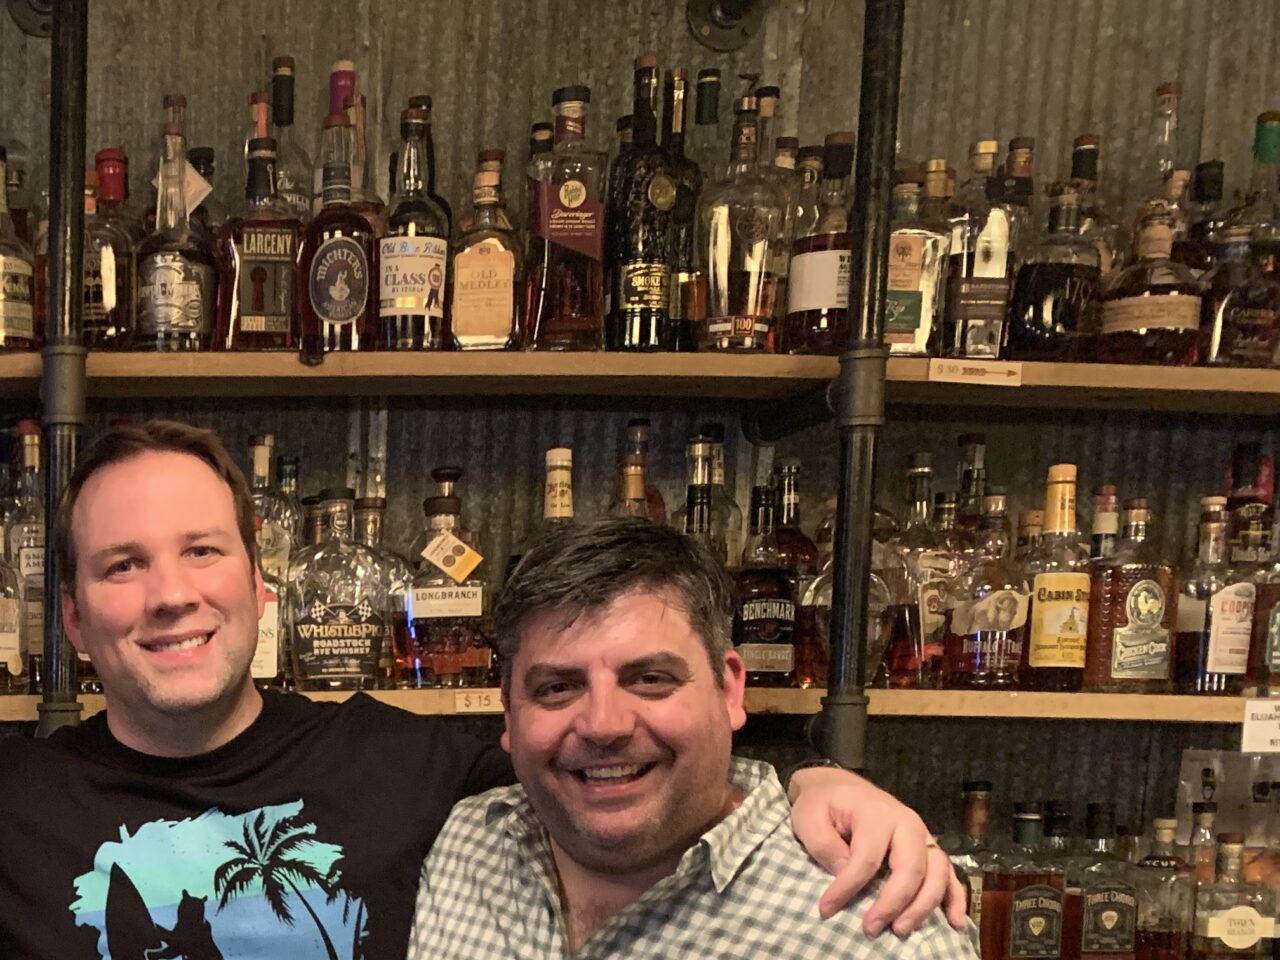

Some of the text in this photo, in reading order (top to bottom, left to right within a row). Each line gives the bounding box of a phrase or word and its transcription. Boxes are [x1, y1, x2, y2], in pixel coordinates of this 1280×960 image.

[243, 232, 292, 254] LARCENY
[384, 273, 426, 287] CLASS
[734, 316, 752, 330] 100
[415, 590, 479, 602] LONGBRANCH
[1037, 587, 1073, 602] CABIN
[463, 695, 472, 708] $
